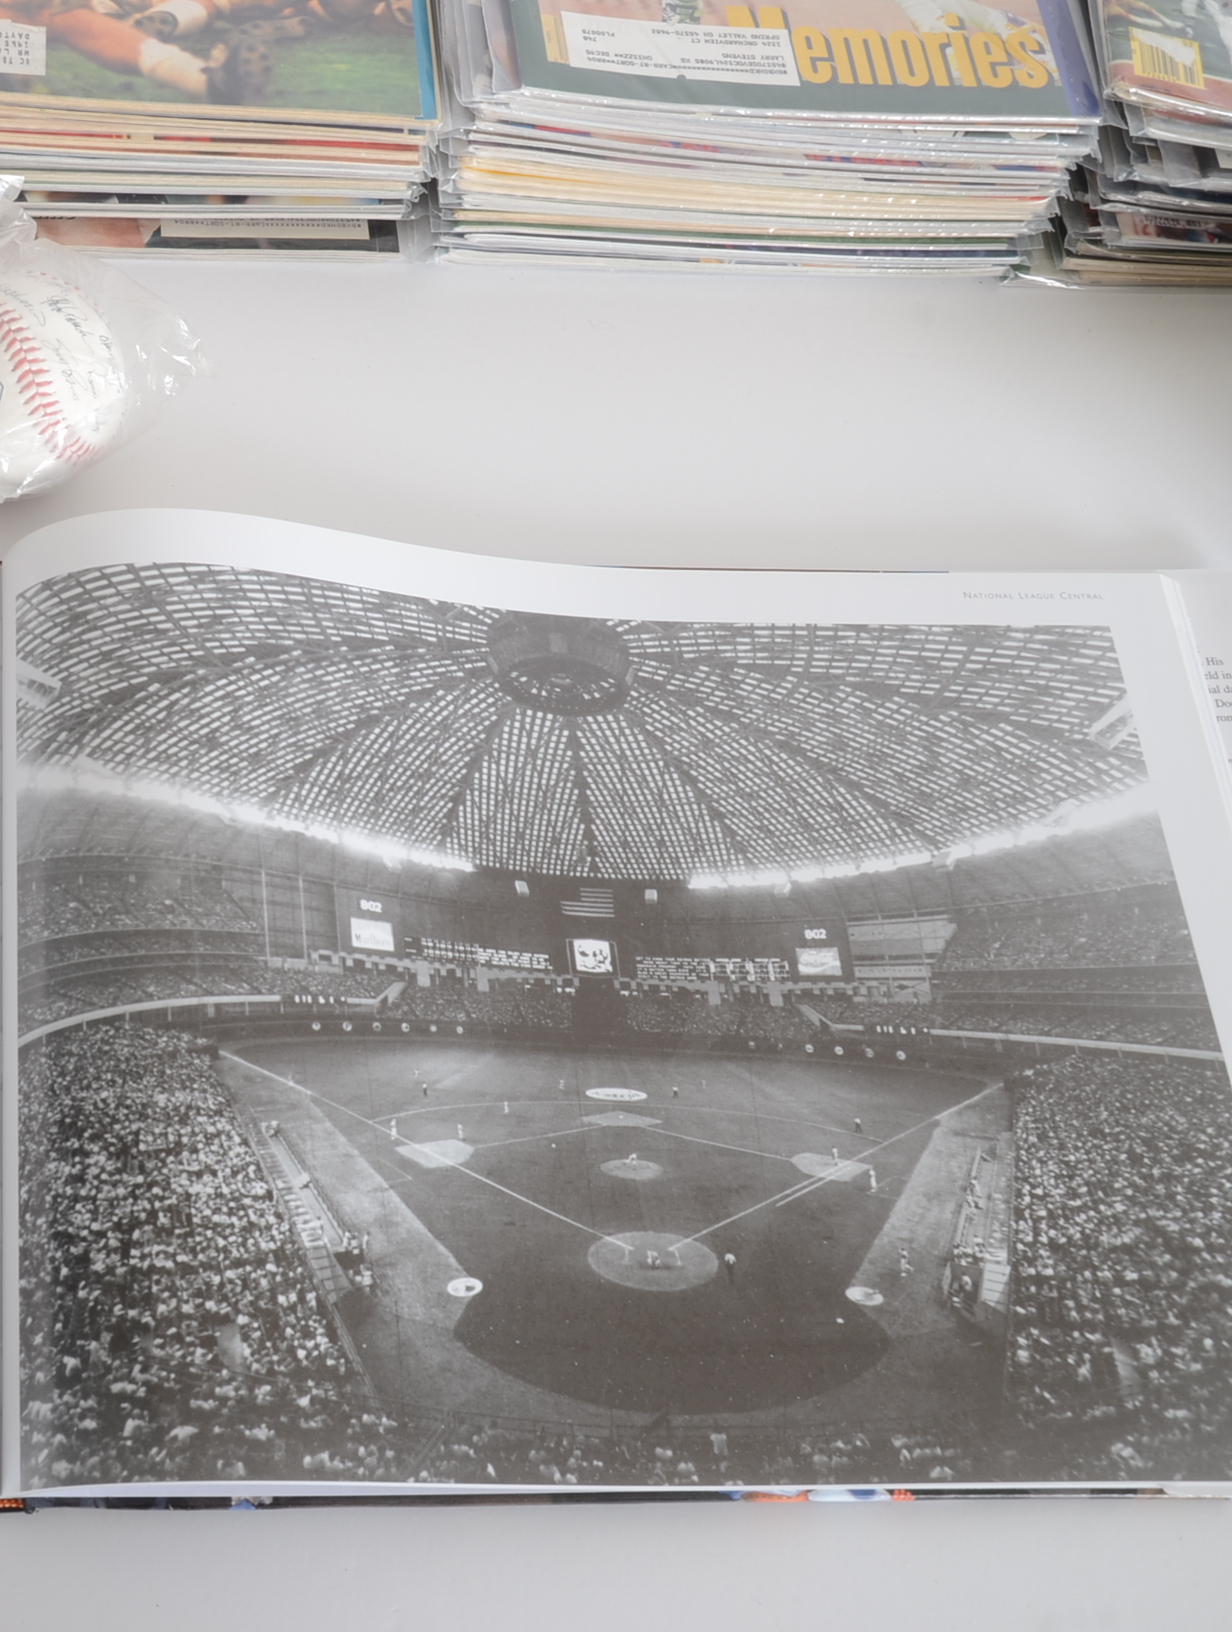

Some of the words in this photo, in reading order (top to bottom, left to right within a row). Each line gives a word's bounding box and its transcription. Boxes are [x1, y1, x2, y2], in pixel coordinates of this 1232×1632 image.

[717, 32, 747, 40] VALLEY
[750, 33, 781, 41] SPRING
[17, 49, 30, 57] MR
[963, 591, 1014, 600] NATIONAL
[1018, 592, 1055, 600] LEAGUE
[1059, 591, 1104, 600] CENTRAL
[1205, 657, 1224, 666] His
